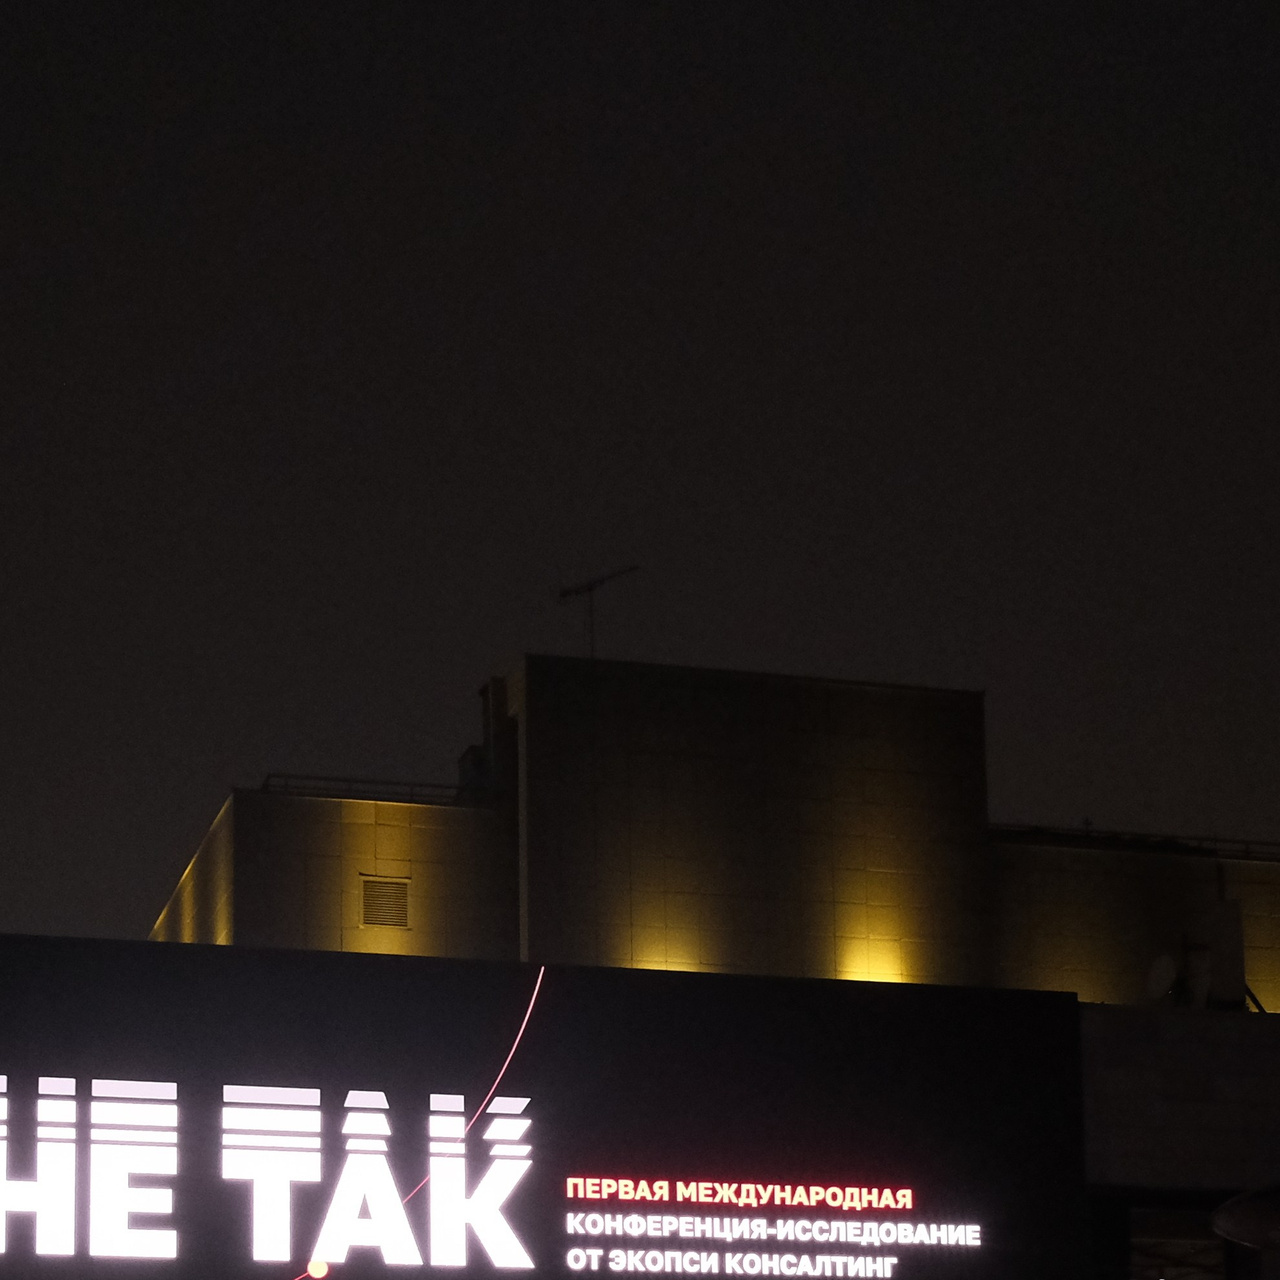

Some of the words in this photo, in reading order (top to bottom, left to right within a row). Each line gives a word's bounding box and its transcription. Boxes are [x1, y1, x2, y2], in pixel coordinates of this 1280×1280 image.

[222, 1085, 535, 1270] ТАК
[566, 1177, 669, 1202] ПЕРВАЯ
[676, 1181, 913, 1211] МЕЖДУНАРОДНАЯ
[566, 1212, 981, 1246] КОНФЕРЕНЦИЯ-ИССЛЕДОВАНИЕ
[566, 1248, 603, 1270] ОТ
[608, 1250, 719, 1274] ЭКОПСИ
[725, 1252, 898, 1278] КОНСАЛТИНГ
